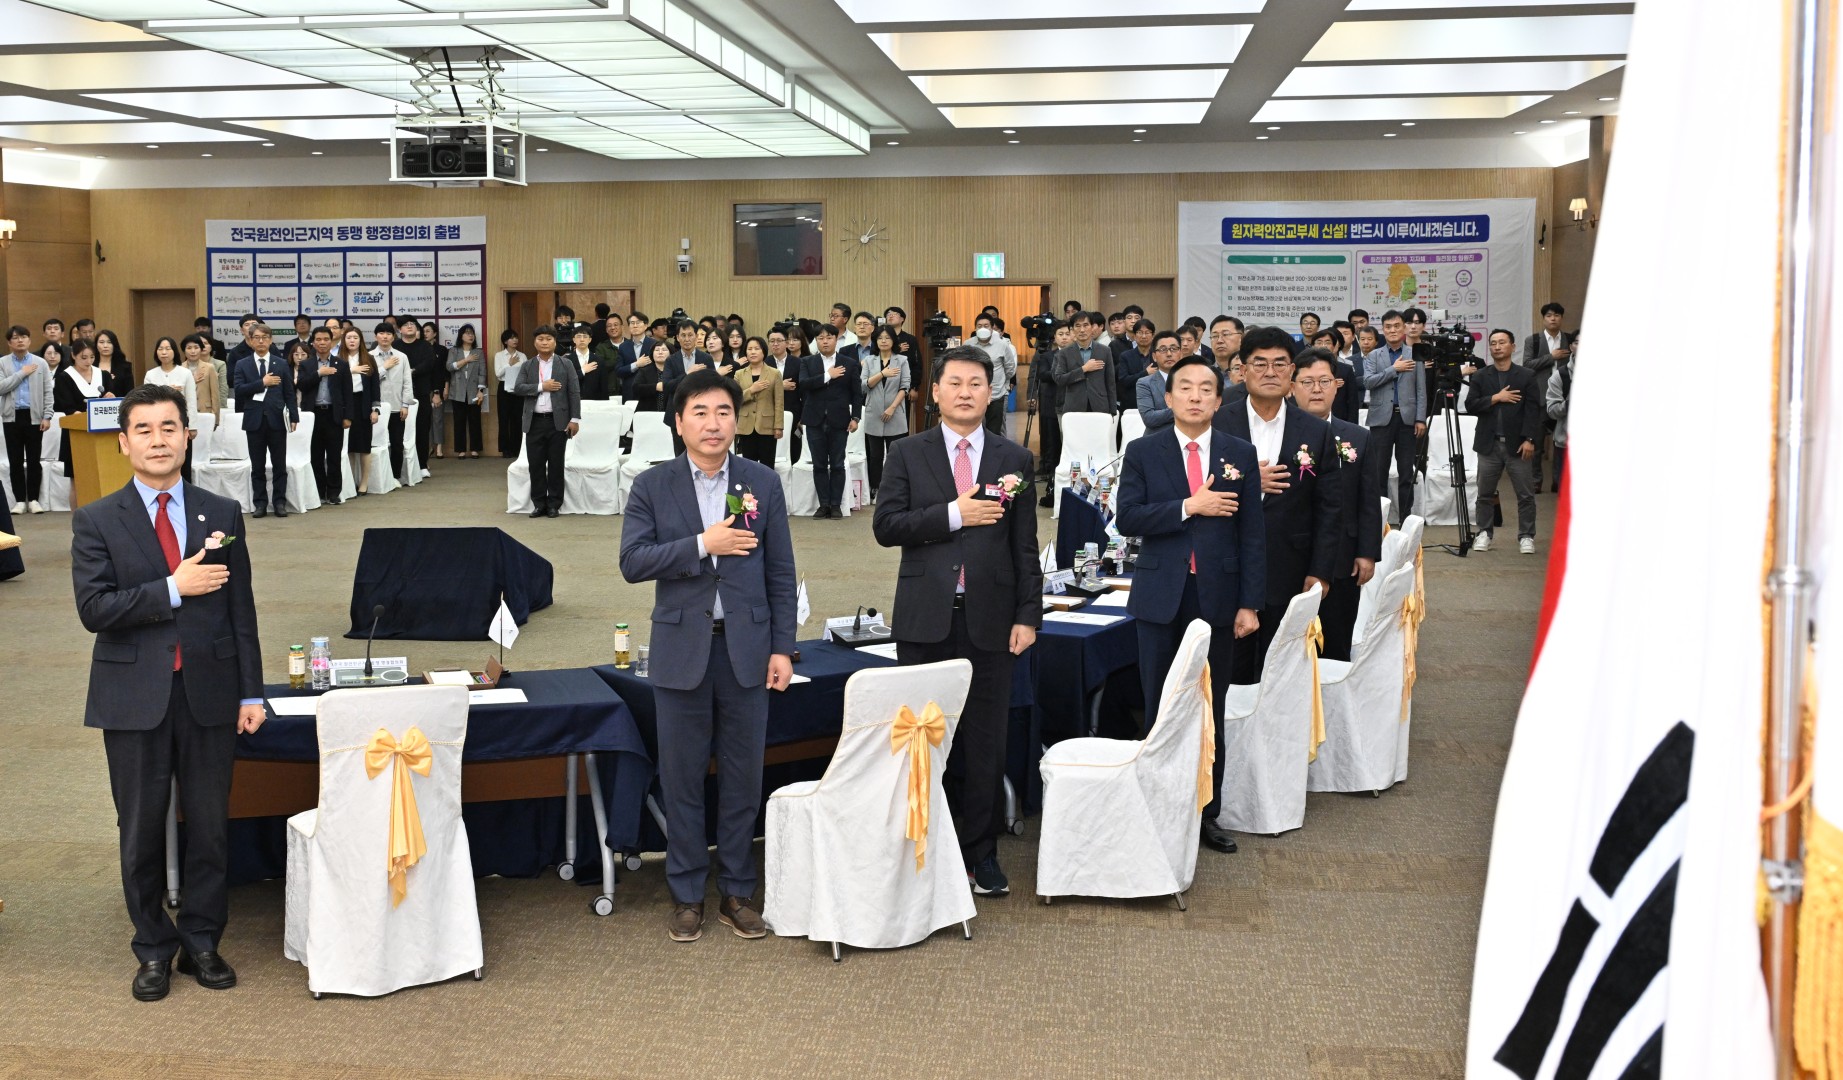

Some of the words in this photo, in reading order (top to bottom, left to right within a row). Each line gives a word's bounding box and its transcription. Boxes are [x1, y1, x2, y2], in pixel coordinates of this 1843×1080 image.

[231, 226, 333, 242] 전국원전인근지역
[337, 226, 362, 241] 동맹
[366, 225, 431, 241] 행정협의회
[434, 224, 460, 240] 출범
[1232, 223, 1319, 239] 원자력안전교부세
[1322, 223, 1347, 239] 신설!
[1350, 223, 1384, 239] 반드시
[1387, 221, 1479, 239] 이루어내겠습니다.
[94, 406, 120, 416] 전국원전인
